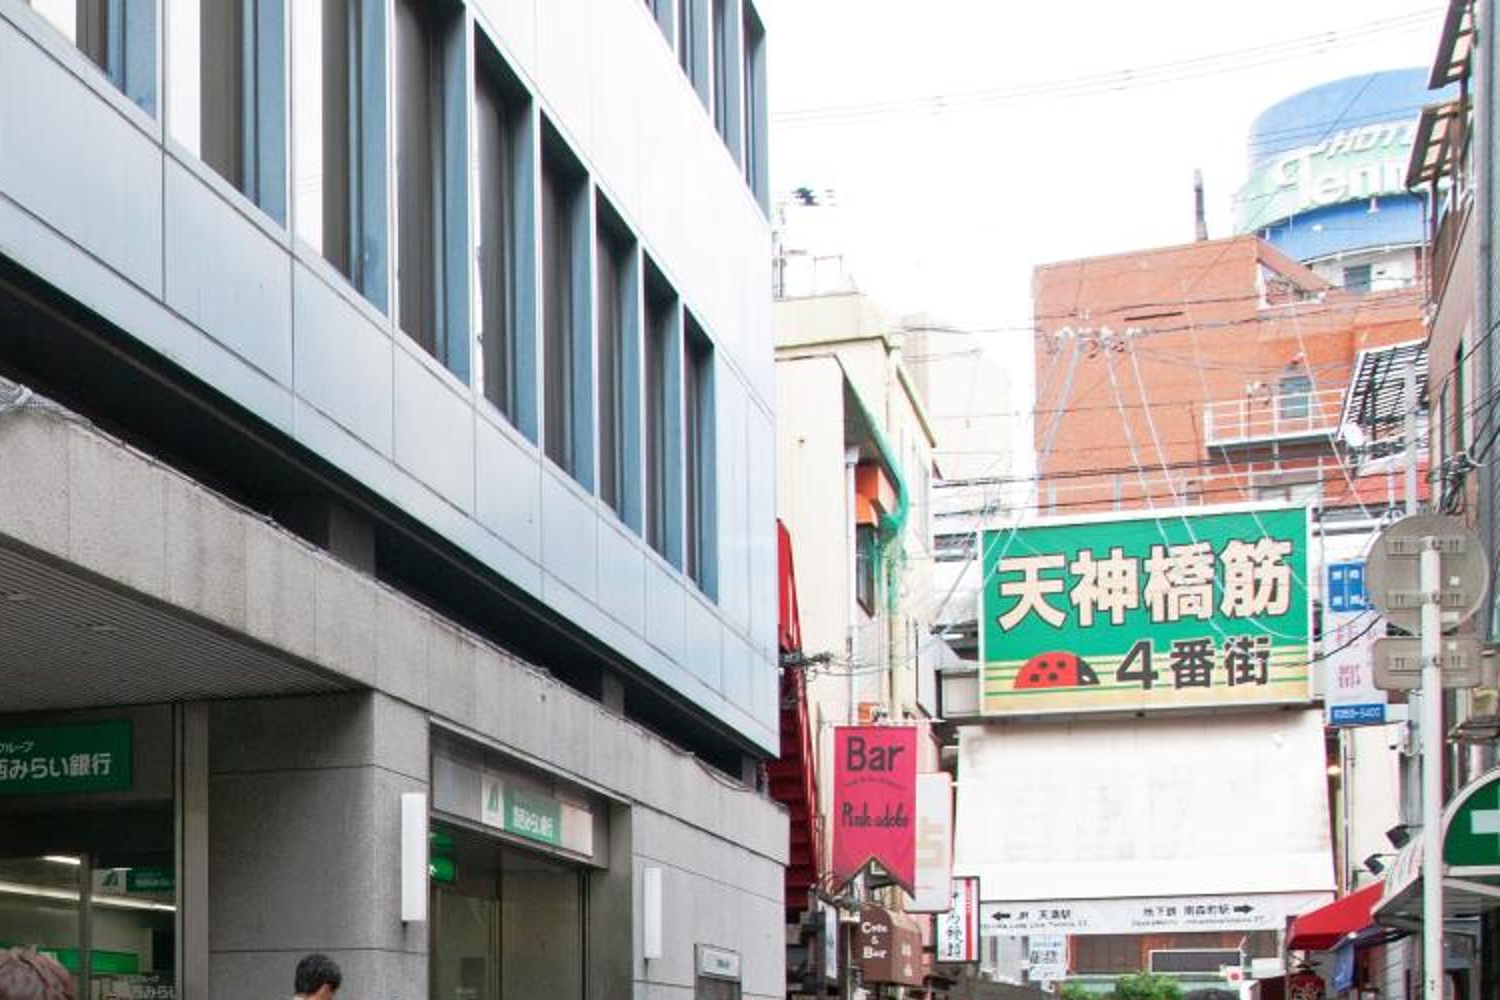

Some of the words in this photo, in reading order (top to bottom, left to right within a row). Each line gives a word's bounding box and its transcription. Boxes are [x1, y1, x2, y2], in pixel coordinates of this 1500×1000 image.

[996, 536, 1293, 633] 天神橋筋
[1115, 635, 1271, 690] 4番街
[846, 736, 906, 772] Bar
